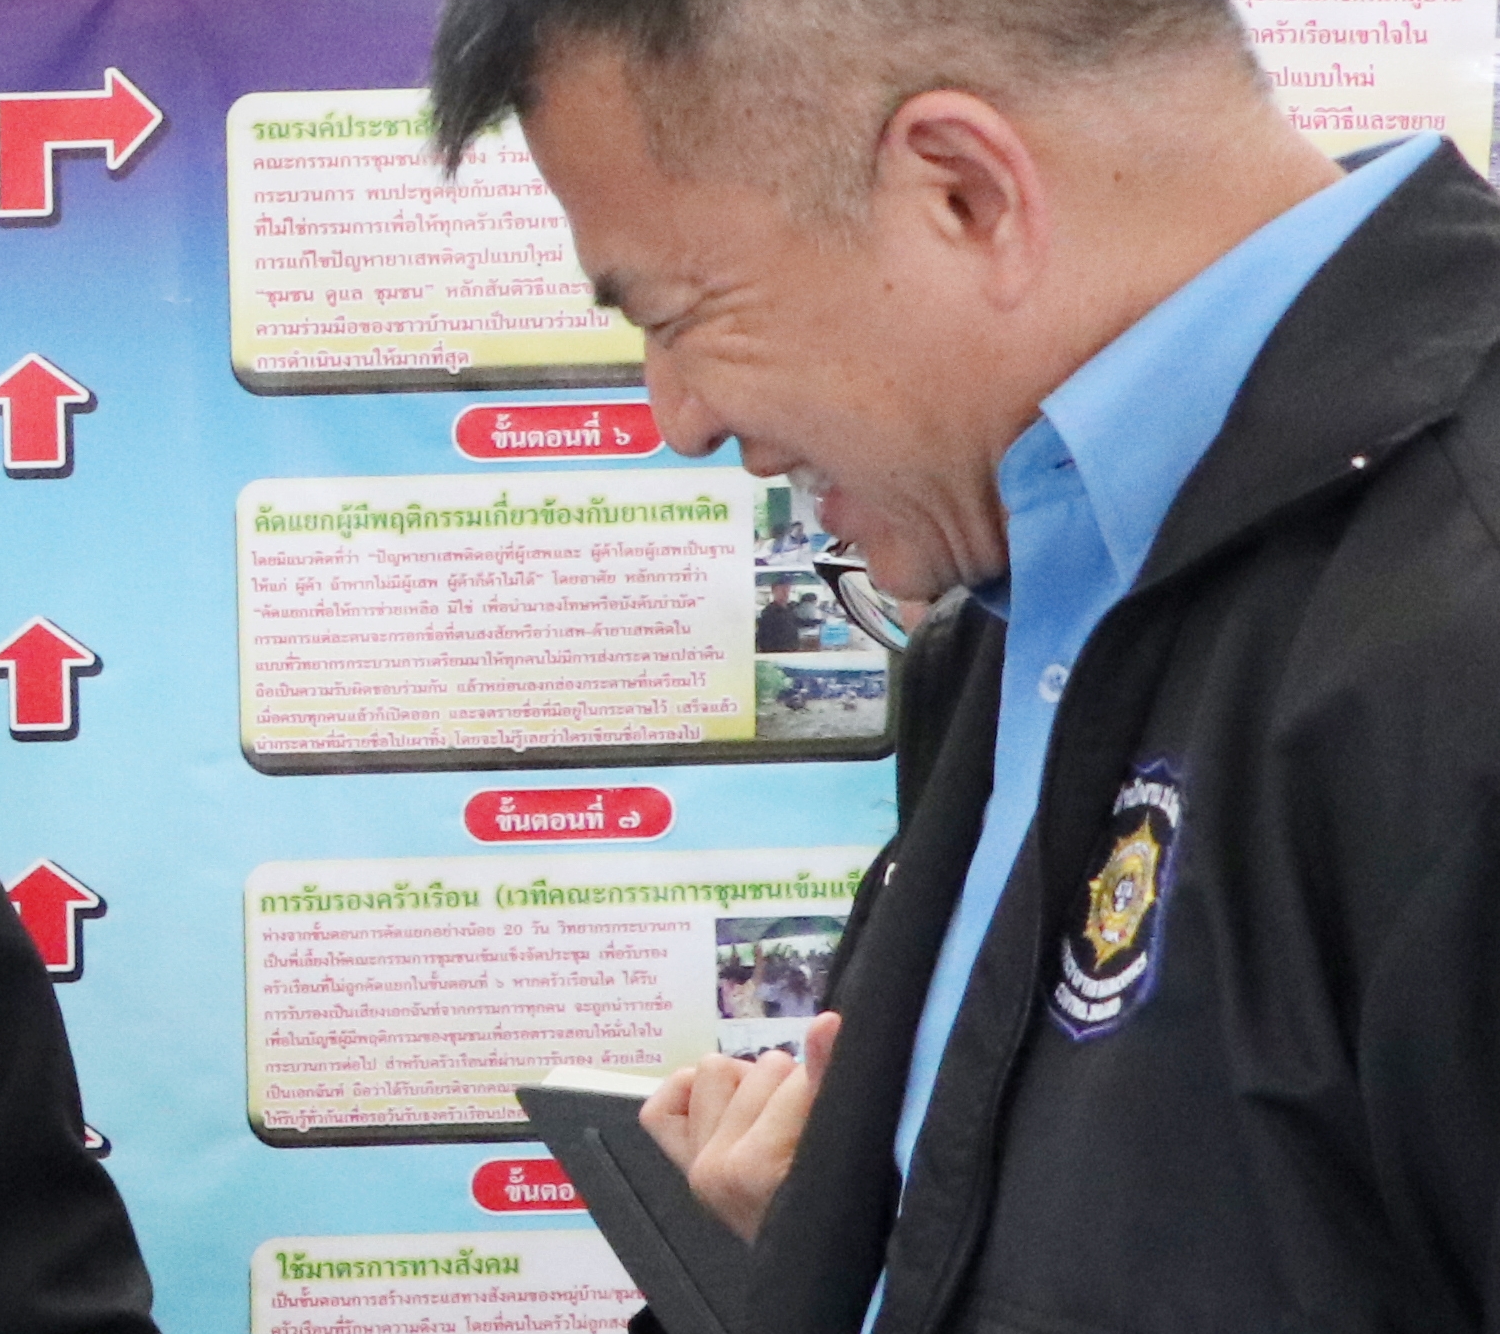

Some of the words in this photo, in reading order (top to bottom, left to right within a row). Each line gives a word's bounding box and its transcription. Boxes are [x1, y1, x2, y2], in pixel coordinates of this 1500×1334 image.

[1248, 19, 1429, 46] ครัวเรือนเขาใจใน
[1266, 62, 1376, 88] ปแบบใหม่
[252, 110, 436, 141] รณรงค์ประชาสั
[253, 188, 355, 204] กระบวนการ
[326, 286, 364, 307] ดูแล
[257, 340, 469, 373] การดำเนินงานให้มากที่สุด
[491, 412, 601, 451] ขั้นตอนที่
[613, 424, 631, 447] ๖
[254, 493, 729, 538] คัดแยกผู้มีพฤติกรรมเกี่ยวข้องกับยาเสพติด
[495, 794, 605, 833] ขั้นตอนที่
[616, 810, 640, 831] ๗
[260, 880, 480, 916] การรับรองครัวเรือน
[494, 867, 862, 914] (เวทีคณะกรรมการชุมชนเข้มแข็
[503, 924, 523, 936] 20
[531, 920, 549, 935] วัน
[504, 1166, 575, 1204] ขั้นตอ
[276, 1247, 520, 1280] ใช้มาตรการทางสังคม
